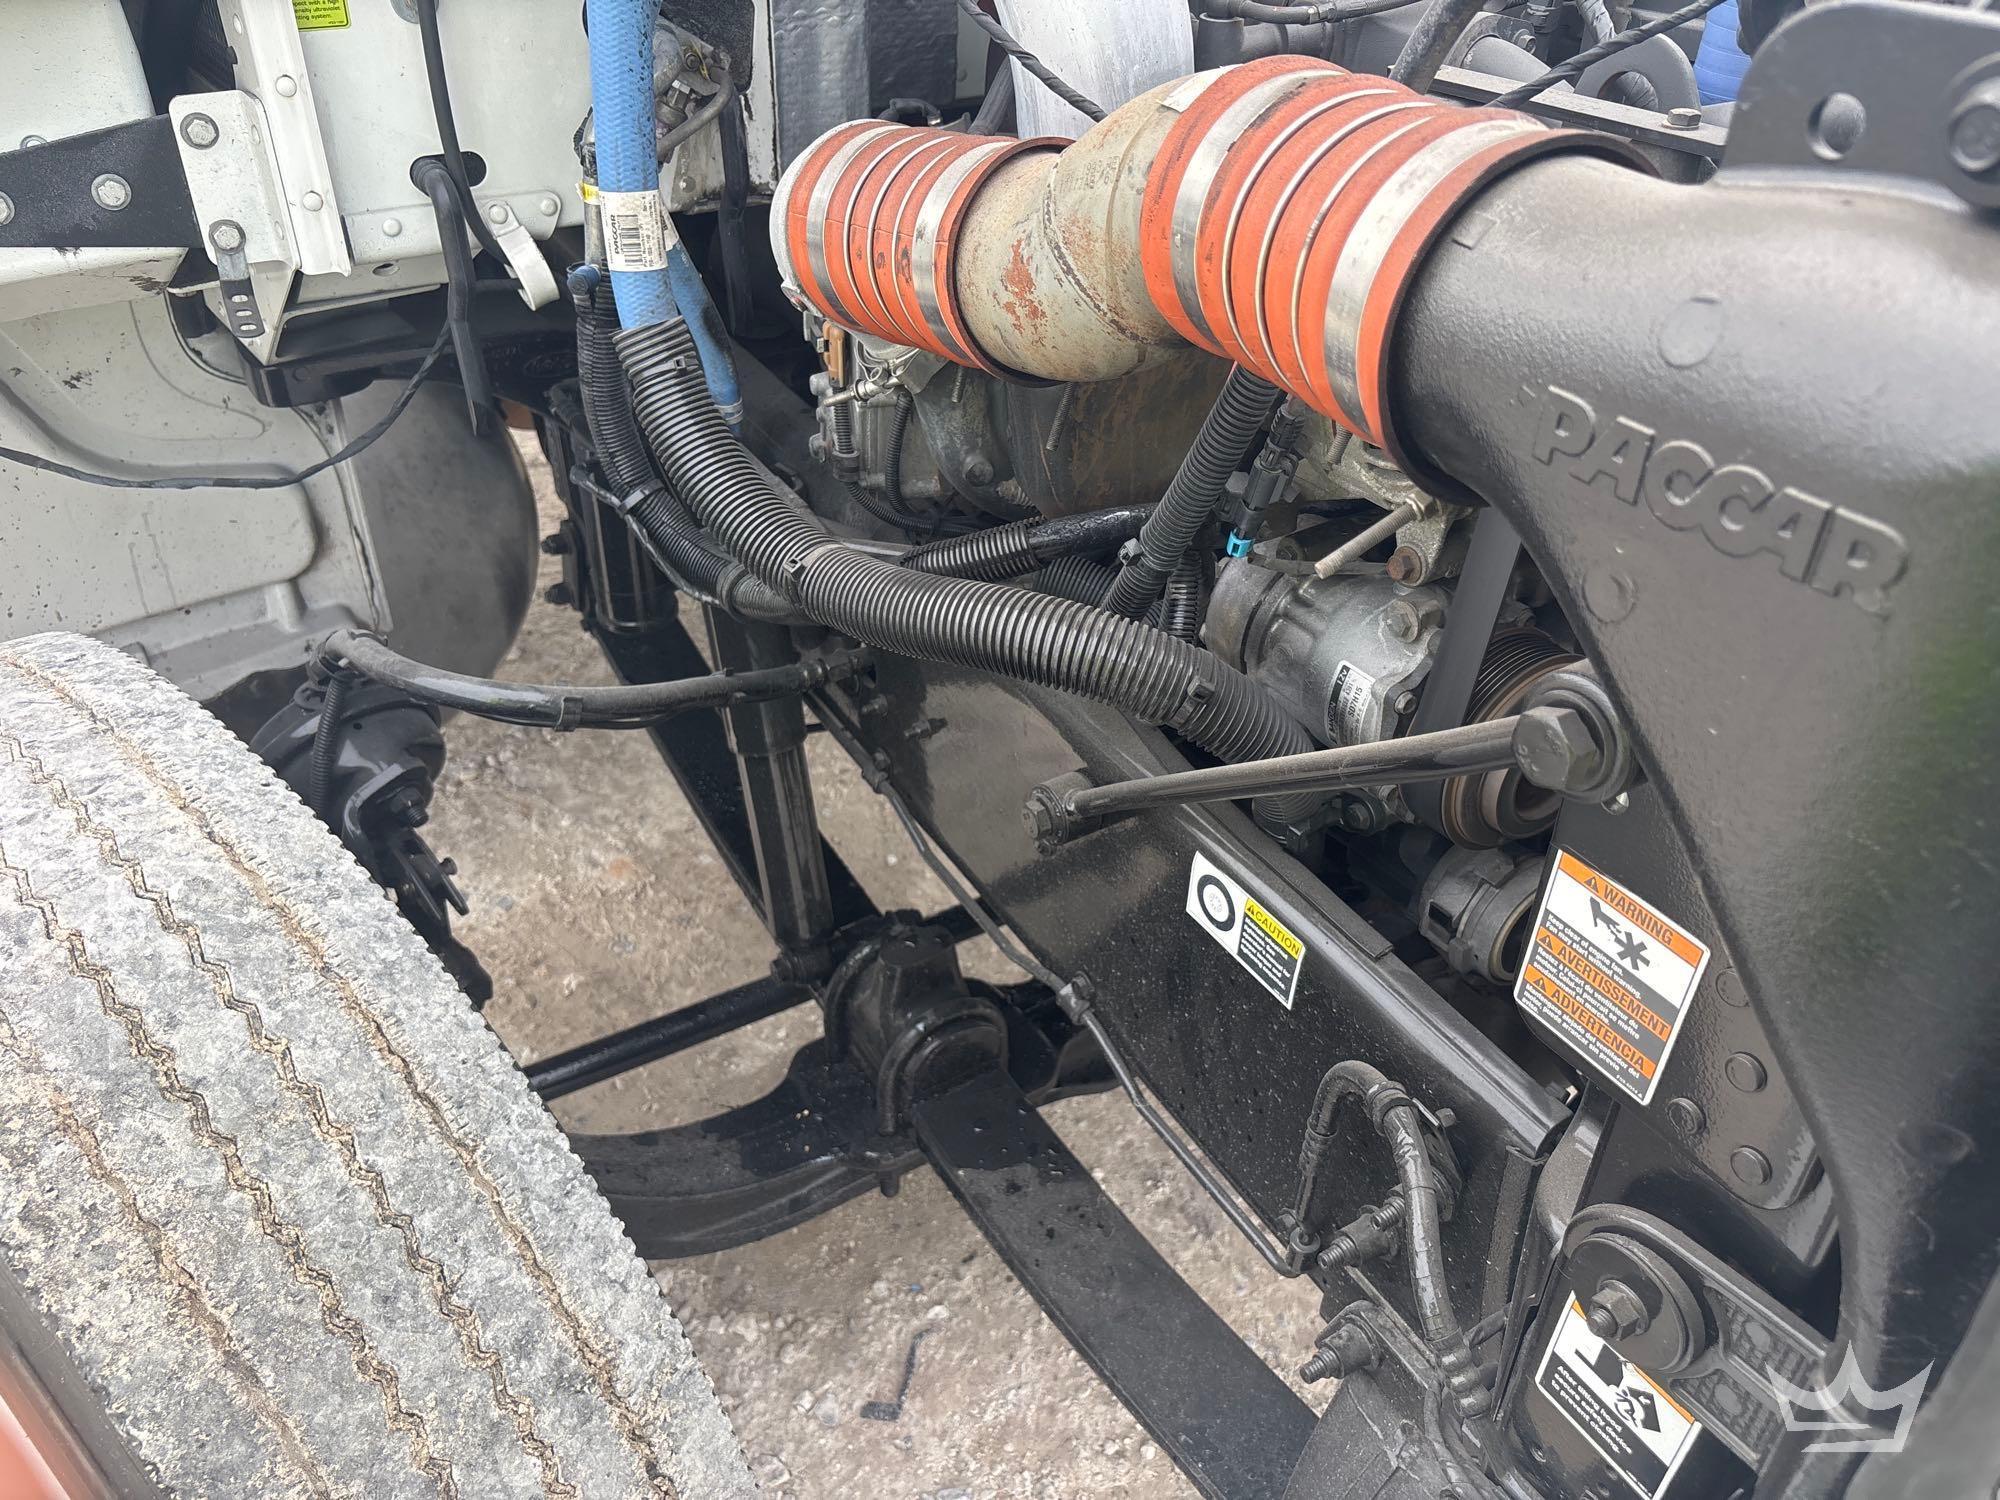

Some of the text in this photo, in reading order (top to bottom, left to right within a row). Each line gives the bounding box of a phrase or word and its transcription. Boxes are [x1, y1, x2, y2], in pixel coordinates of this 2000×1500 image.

[611, 214, 620, 255] PACCAR
[1532, 384, 1910, 622] PACCAR
[1336, 668, 1348, 686] 12V
[1347, 685, 1363, 718] SD7H15
[1254, 908, 1299, 956] CAUTION
[1547, 913, 1624, 976] Keep clear of engine fan.
[1602, 884, 1674, 946] WARNING
[1533, 960, 1611, 1025] soudainement en marche.
[1537, 946, 1558, 966] Restez
[1584, 983, 1593, 994] du
[1593, 990, 1628, 1020] ventilateur
[1628, 1017, 1638, 1029] du
[1545, 920, 1642, 1000] Fan may start without warning.
[1556, 943, 1668, 1038] AVERTISSEMENT
[1521, 996, 1539, 1014] aviso.
[1523, 989, 1620, 1072] motor, puede arrancar sin previo
[1535, 954, 1640, 1040] moteur. Celui-ci pourrait se mettre
[1550, 986, 1646, 1071] ADVERTENCIA
[1561, 1012, 1584, 1035] alejado
[1584, 1031, 1595, 1043] del
[1595, 1040, 1627, 1069] ventilador
[1627, 1066, 1639, 1079] del
[1550, 1379, 1621, 1455] to prevent closing.
[1553, 1371, 1633, 1455] secure safety device
[1557, 1363, 1622, 1433] After tilting hood
